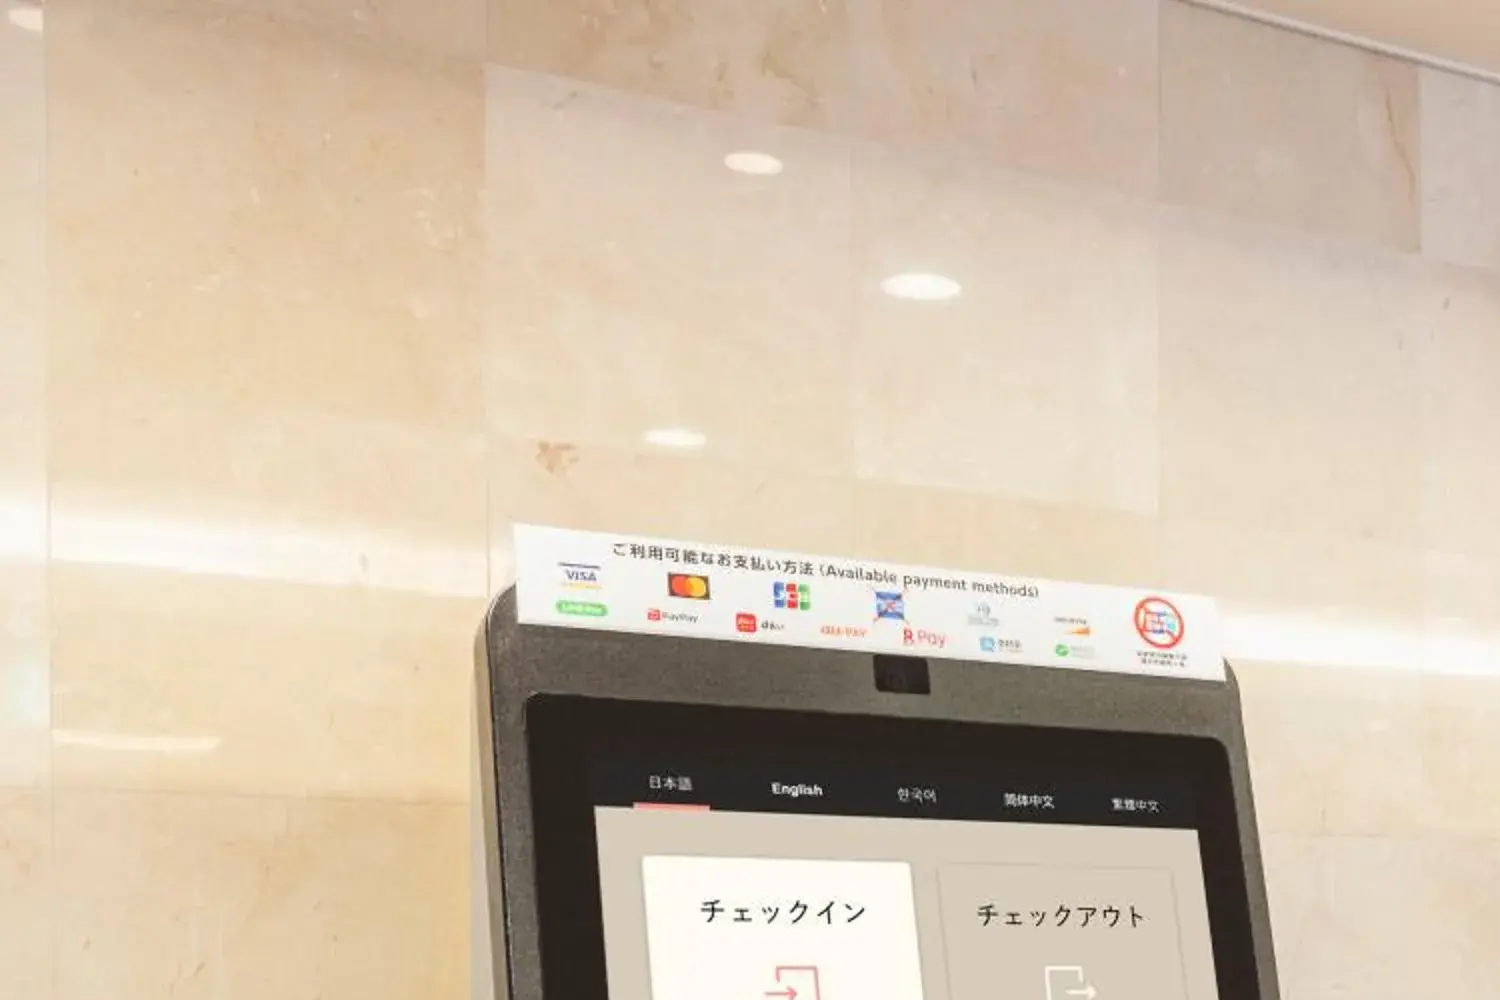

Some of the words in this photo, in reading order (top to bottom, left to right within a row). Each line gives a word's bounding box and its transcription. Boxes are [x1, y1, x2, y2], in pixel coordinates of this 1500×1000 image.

[564, 569, 598, 582] VISA
[903, 574, 967, 593] payment
[972, 579, 1040, 598] methods)
[917, 629, 947, 648] Pay
[649, 775, 693, 792] 日本語
[771, 782, 823, 798] English
[897, 787, 937, 802] 한국어
[700, 898, 866, 926] チェックイン
[977, 902, 1145, 929] チェックアウト
